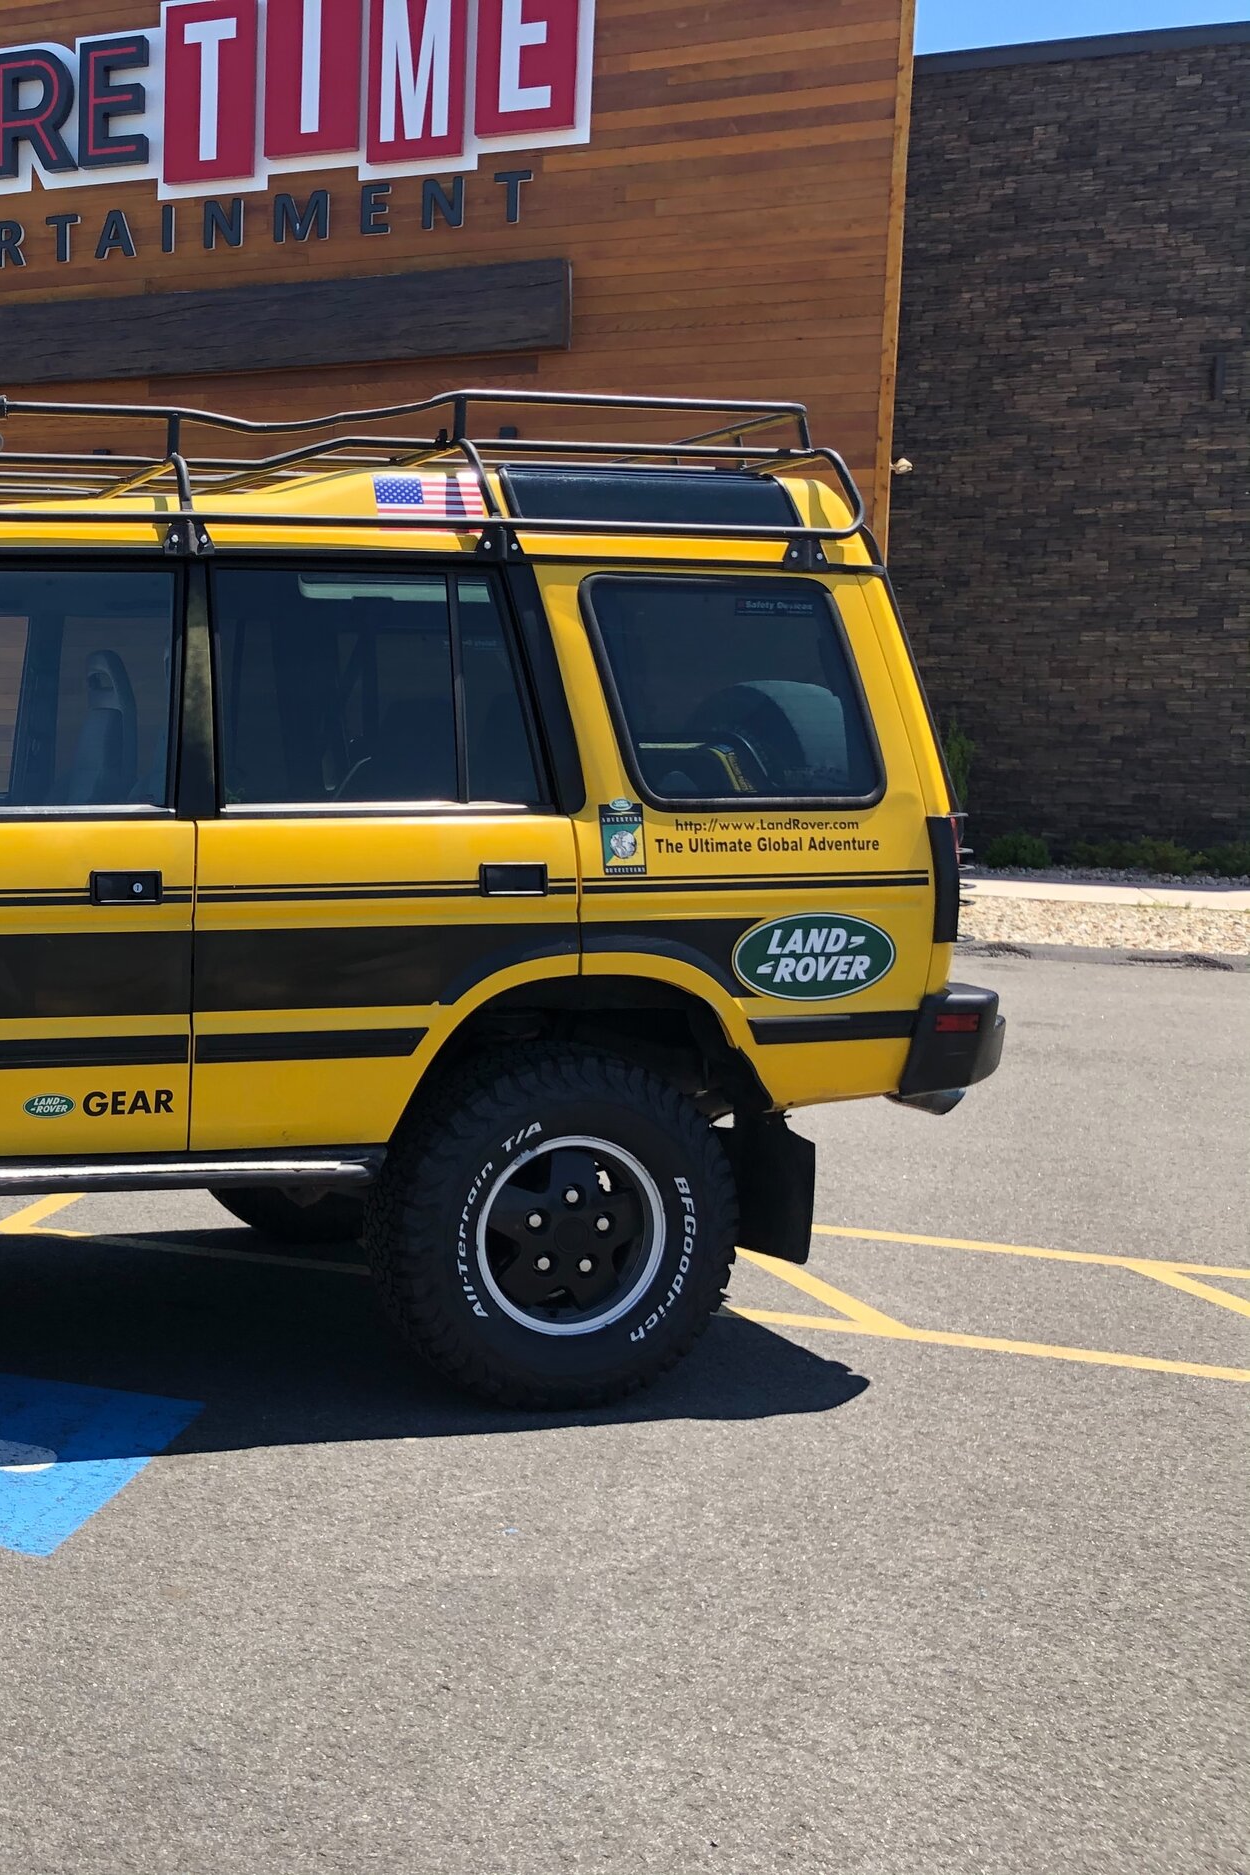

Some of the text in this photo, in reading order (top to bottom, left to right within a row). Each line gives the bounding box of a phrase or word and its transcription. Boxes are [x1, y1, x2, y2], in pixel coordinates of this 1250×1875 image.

[183, 0, 552, 162] TIME
[745, 600, 775, 611] Safety
[675, 818, 859, 834] http://www.LandRover.com
[654, 836, 880, 854] The Ultimate Global Adventure
[82, 1089, 174, 1117] GEAR
[456, 1121, 543, 1319] All-Terrain T/A
[630, 1176, 696, 1342] BFGoodrich
